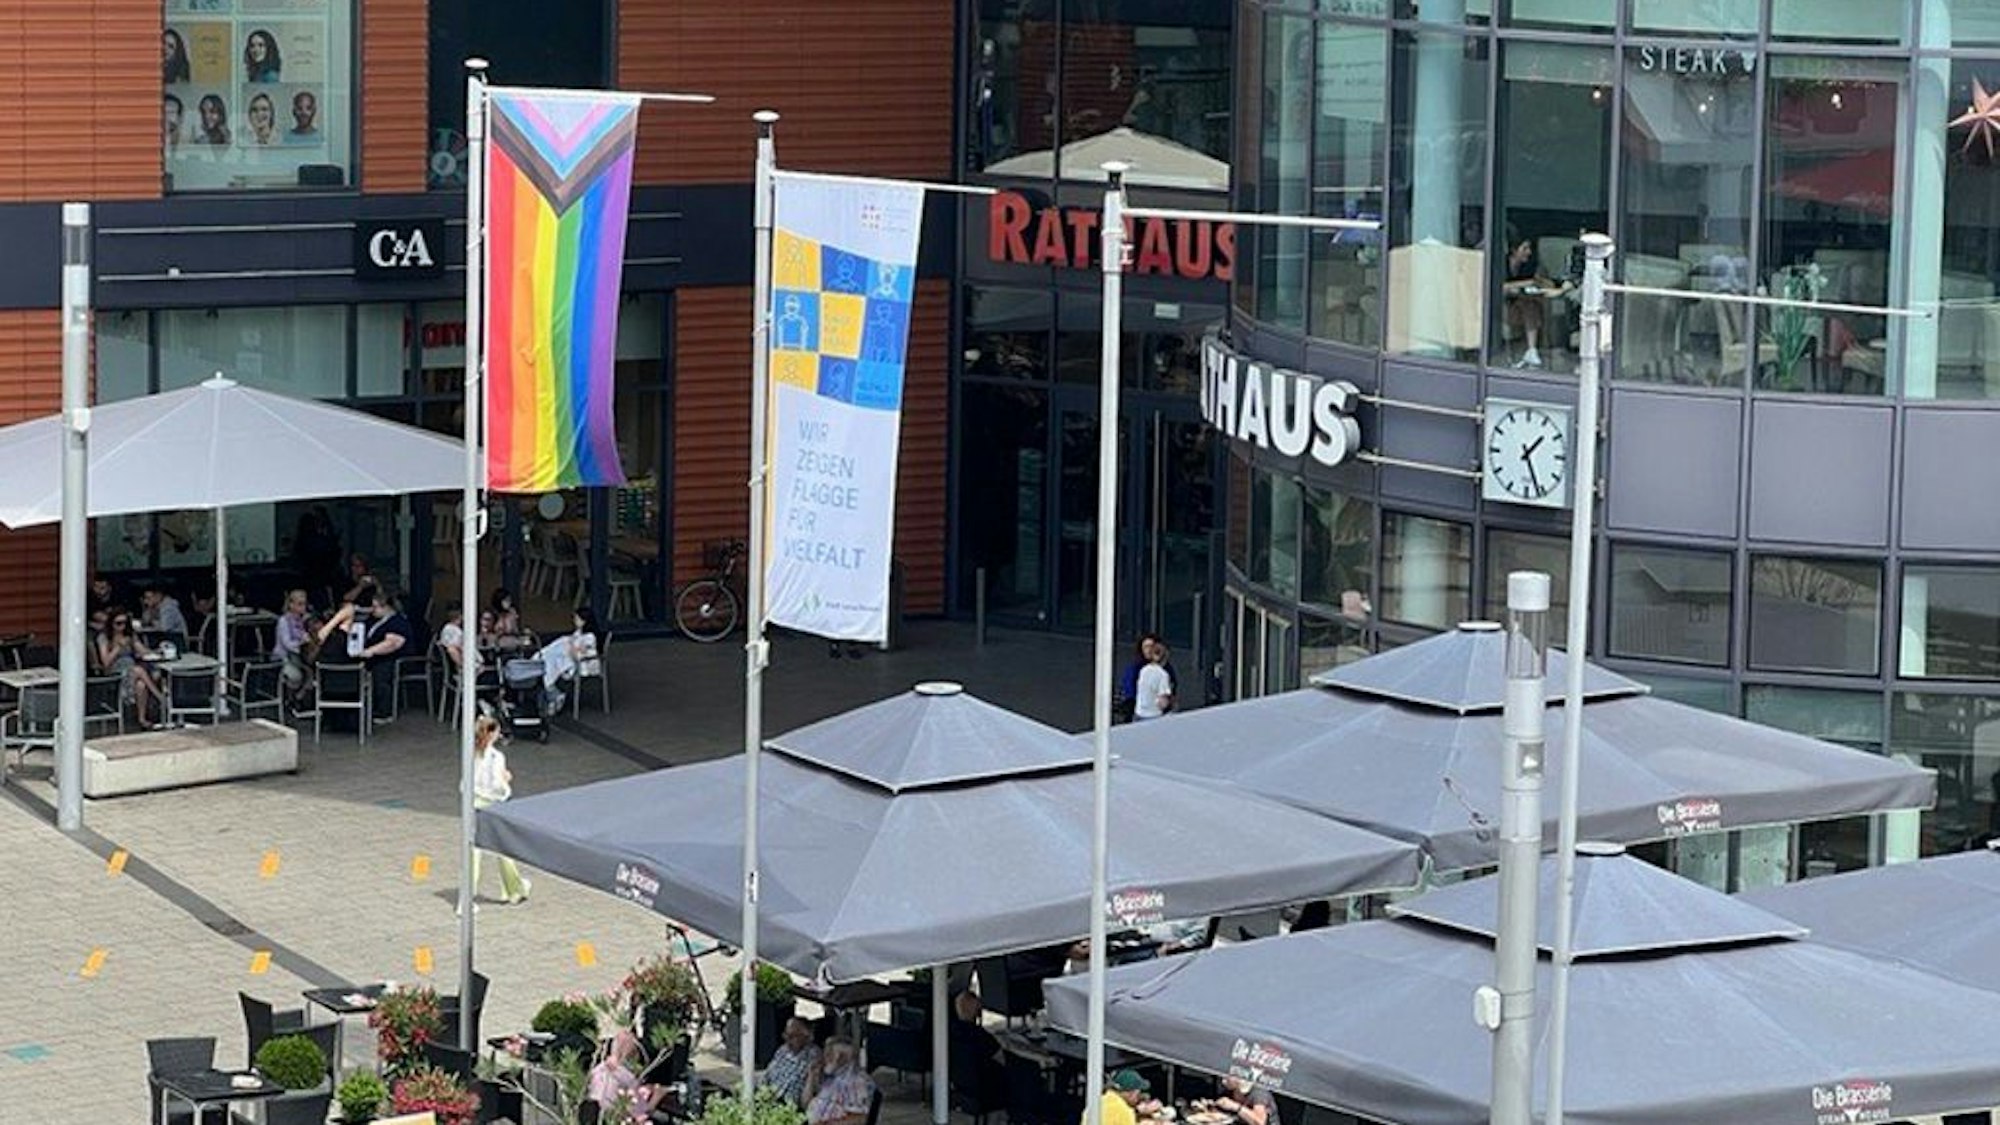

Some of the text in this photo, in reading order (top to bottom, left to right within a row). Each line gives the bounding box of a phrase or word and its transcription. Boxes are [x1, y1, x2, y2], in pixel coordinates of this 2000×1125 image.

[1640, 45, 1727, 75] STEAK
[369, 228, 435, 268] C&A
[1201, 335, 1350, 467] THAUS
[798, 419, 830, 441] WIR
[796, 447, 857, 480] ZEIGEN
[791, 477, 861, 511] FLAGGE
[1812, 1081, 1892, 1110] Die Brasserie
